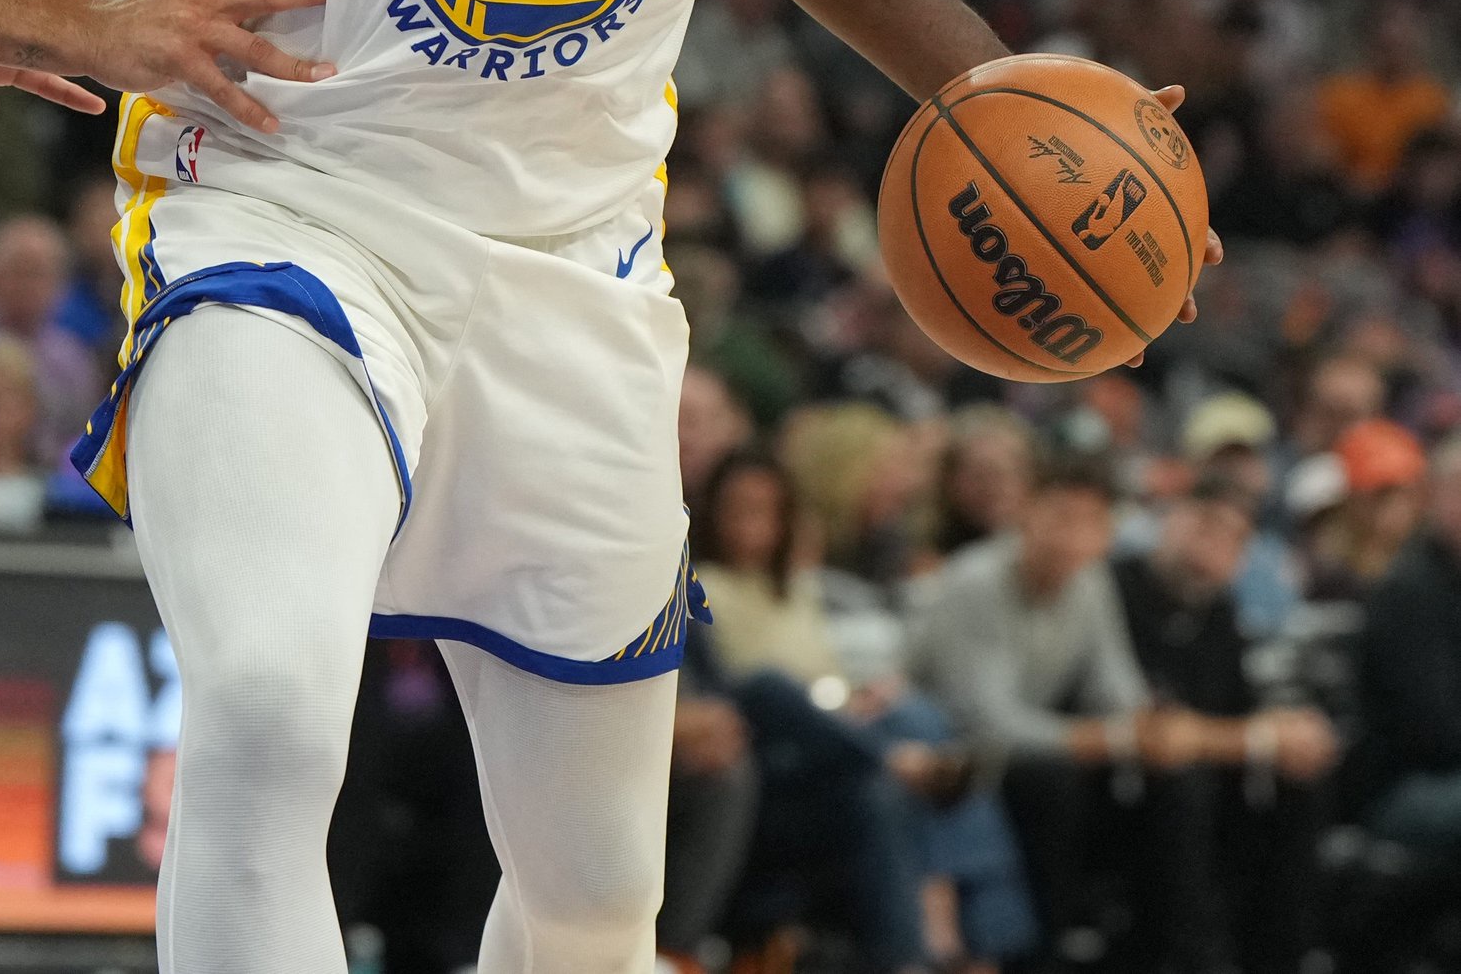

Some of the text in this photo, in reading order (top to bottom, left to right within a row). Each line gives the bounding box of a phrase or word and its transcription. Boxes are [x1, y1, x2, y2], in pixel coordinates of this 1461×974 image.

[1047, 134, 1084, 167] COMMISSIONER
[1124, 229, 1141, 250] BALL
[1134, 243, 1152, 265] GAME
[947, 179, 1104, 366] Wilson
